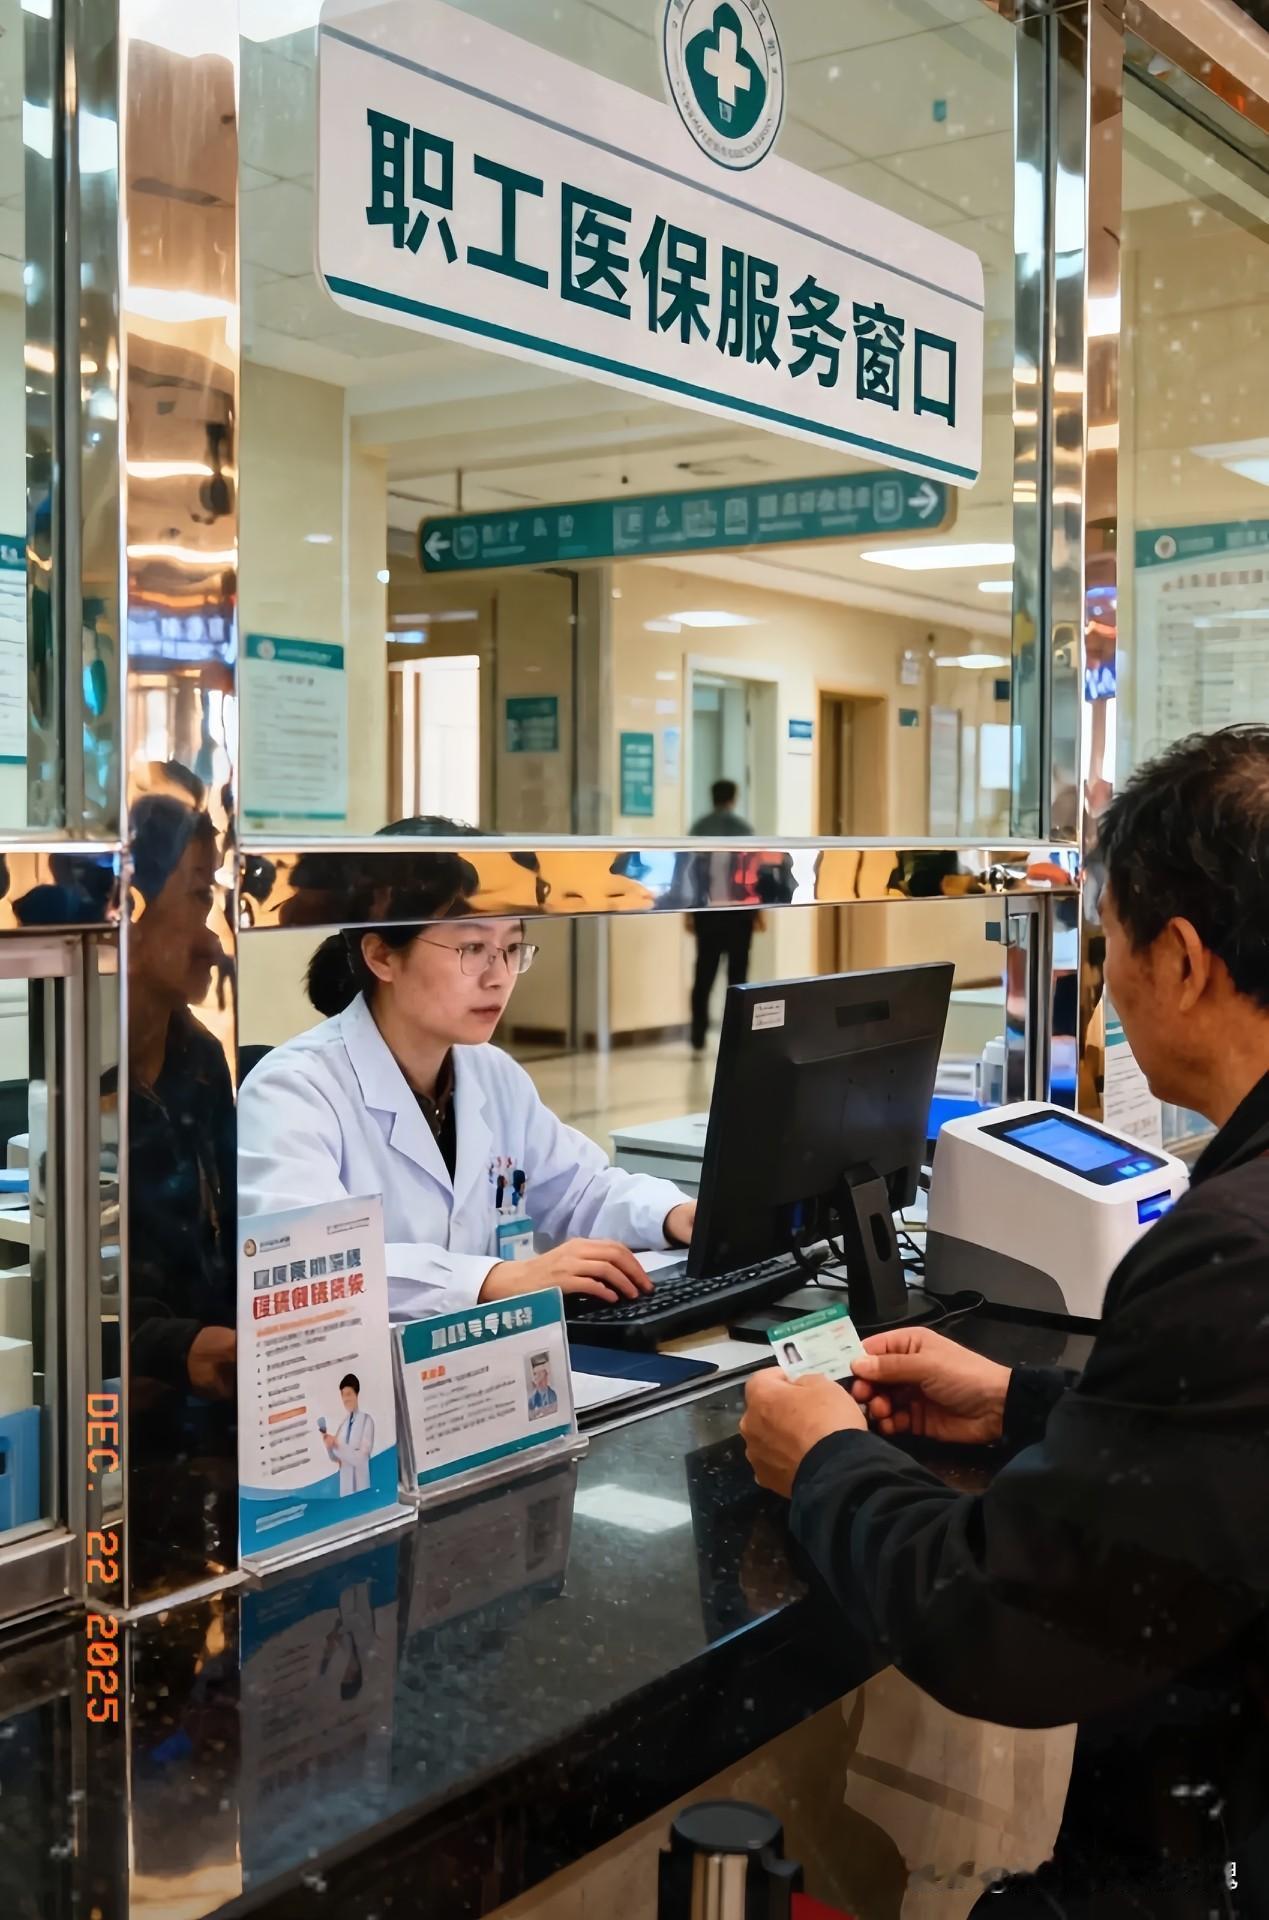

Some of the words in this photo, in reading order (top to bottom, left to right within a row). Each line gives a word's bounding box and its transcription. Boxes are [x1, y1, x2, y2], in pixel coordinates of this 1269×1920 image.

[366, 108, 957, 428] 职工医保服务窗口
